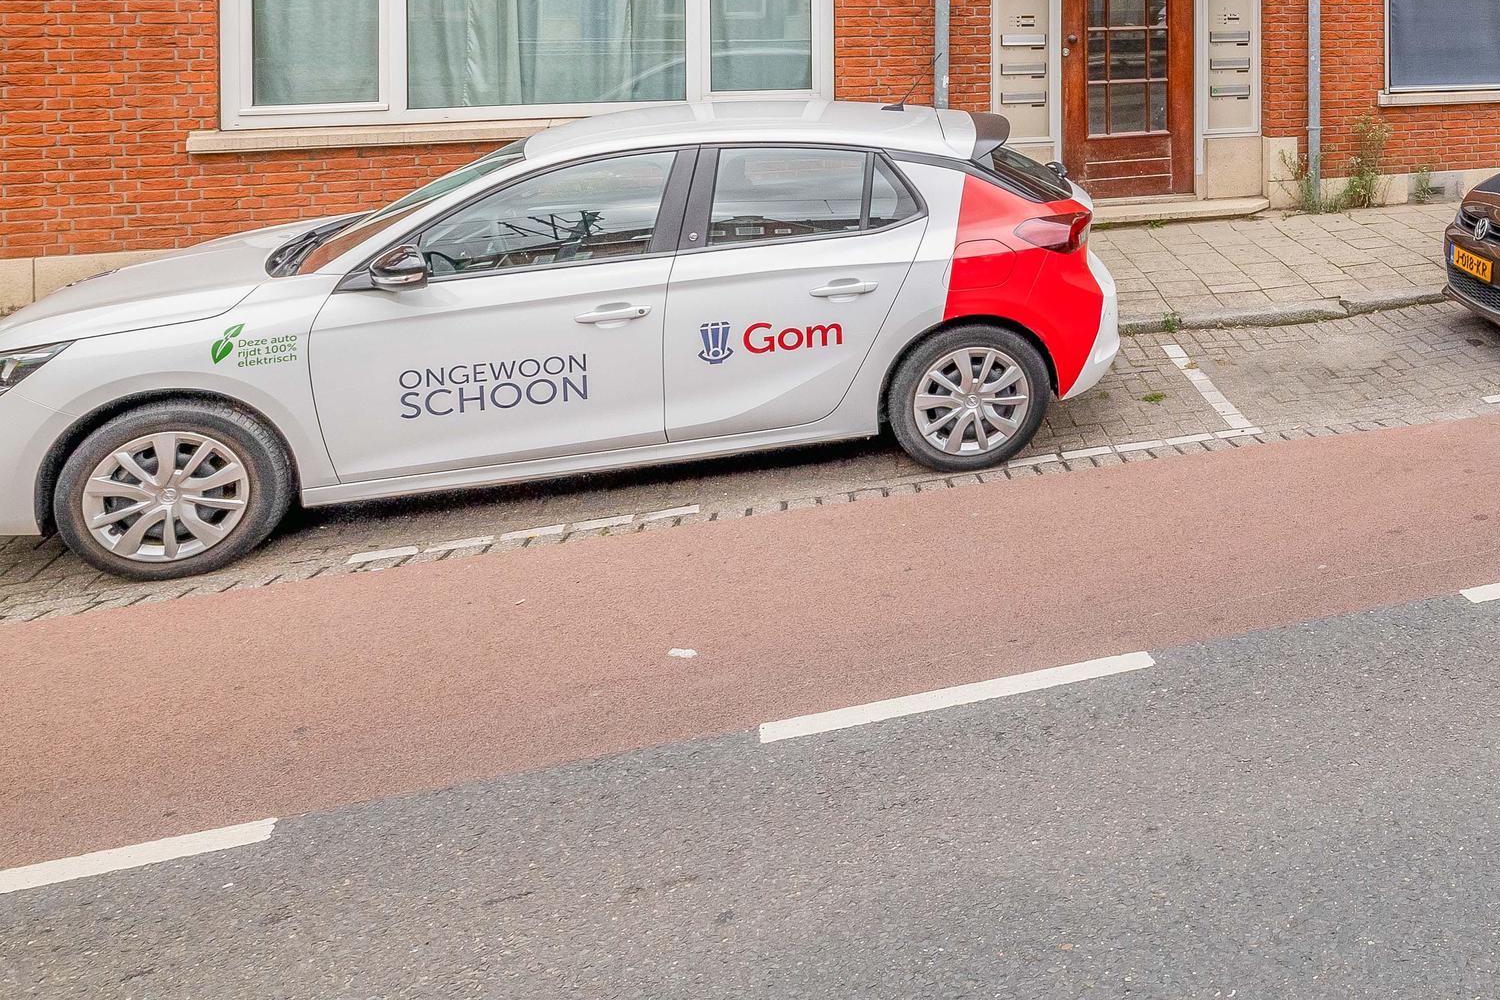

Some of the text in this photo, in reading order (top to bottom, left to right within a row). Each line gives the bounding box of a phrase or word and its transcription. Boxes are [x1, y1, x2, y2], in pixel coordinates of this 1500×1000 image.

[1456, 249, 1488, 278] J-018-KR
[238, 334, 298, 348] Deze auto
[238, 343, 297, 360] rijdt 100%
[743, 322, 843, 354] Gom
[237, 353, 297, 368] elektrisch
[399, 353, 587, 390] ONGEWOON
[400, 374, 588, 420] SCHOON
